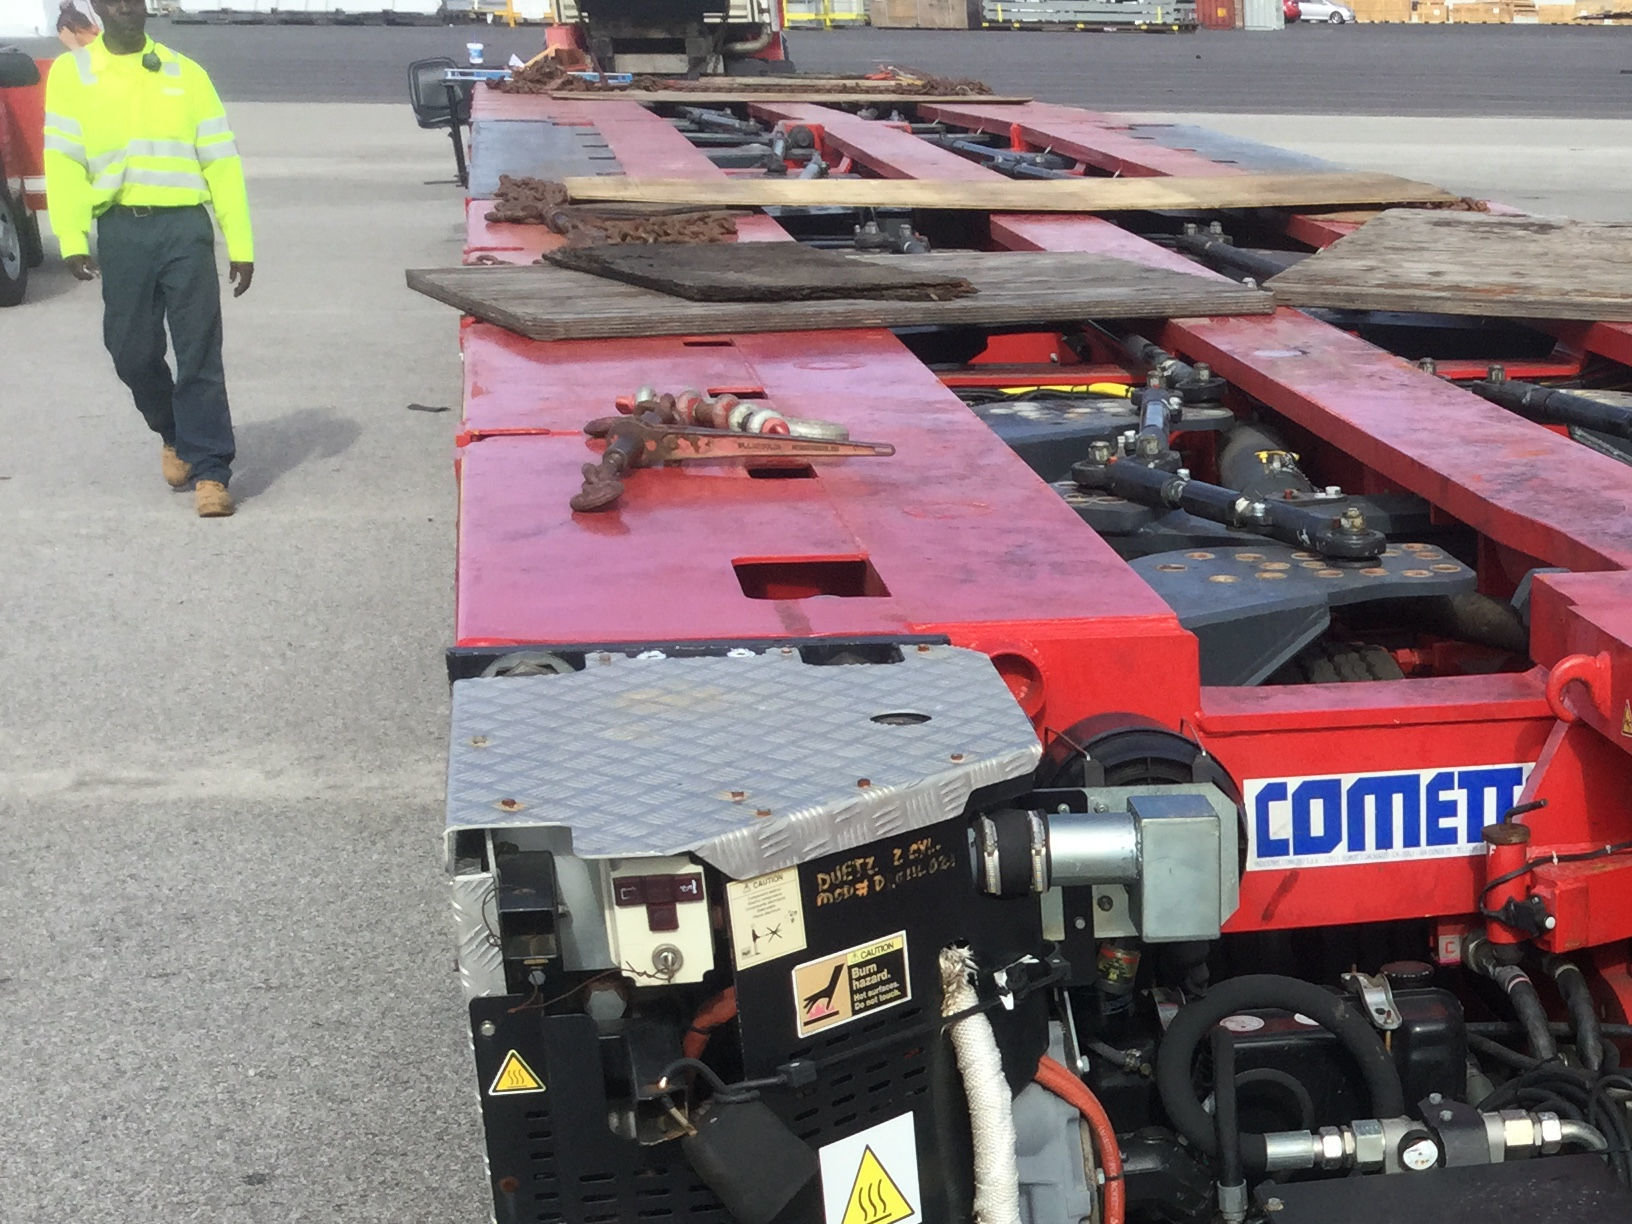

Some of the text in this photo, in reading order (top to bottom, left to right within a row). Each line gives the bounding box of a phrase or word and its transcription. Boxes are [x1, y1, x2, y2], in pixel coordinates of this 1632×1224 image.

[1255, 767, 1534, 868] COMETT
[753, 873, 784, 889] CAUTION
[861, 942, 894, 960] CAUTION
[851, 963, 877, 979] Burn
[853, 969, 892, 990] hazard.
[854, 982, 900, 1002] Hot surfaces.
[854, 990, 902, 1011] Do not touch.
